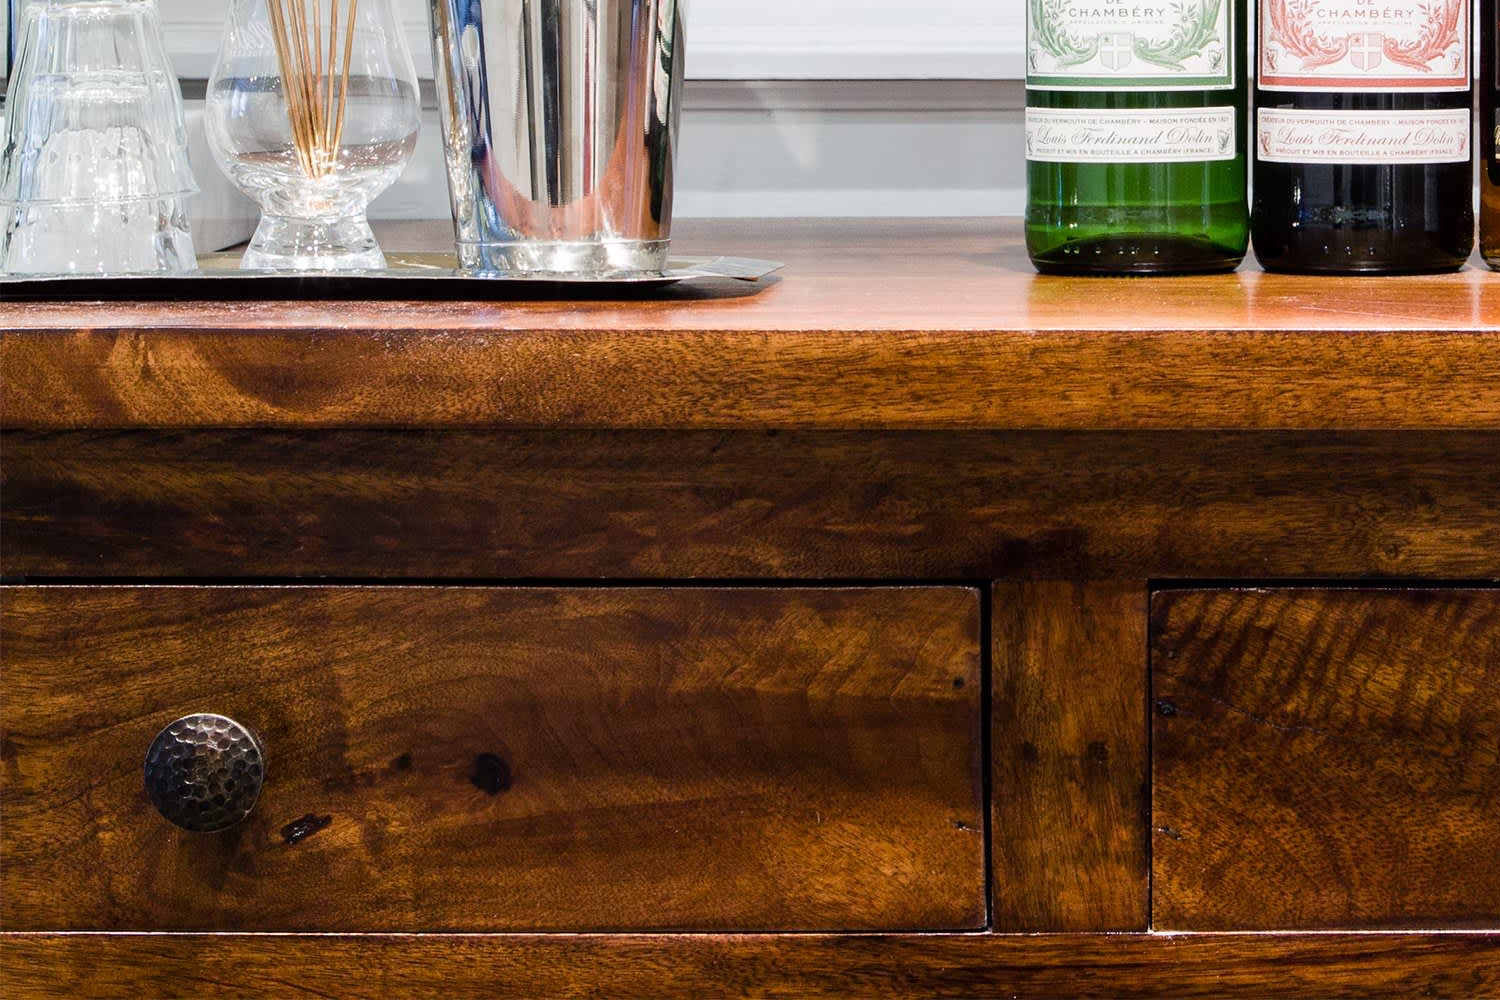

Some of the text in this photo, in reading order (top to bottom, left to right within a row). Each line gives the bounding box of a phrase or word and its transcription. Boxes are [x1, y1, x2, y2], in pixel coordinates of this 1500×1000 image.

[1068, 5, 1165, 17] CHAMBÉRY
[1317, 6, 1414, 18] CHAMBÉRY
[1038, 125, 1212, 145] Louis Ferdinand Dolin
[1277, 126, 1454, 145] Louis Ferdinand Dolin
